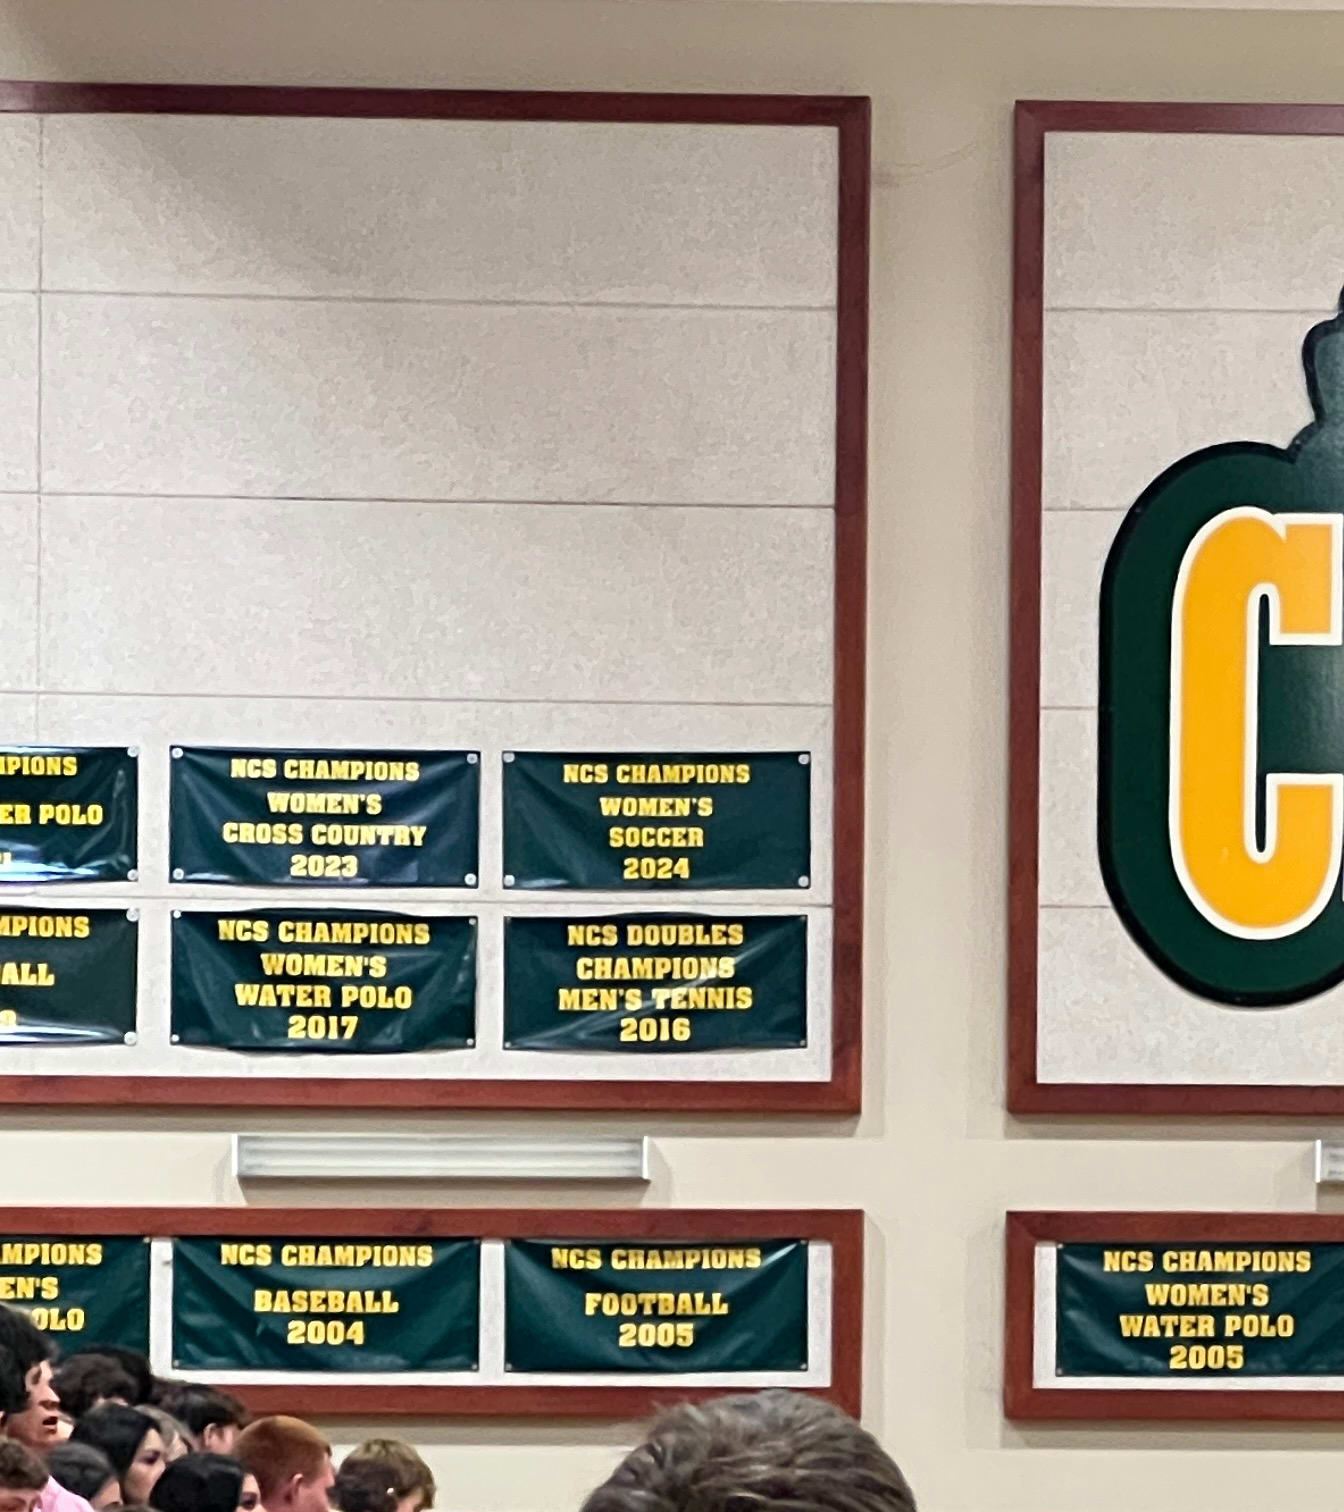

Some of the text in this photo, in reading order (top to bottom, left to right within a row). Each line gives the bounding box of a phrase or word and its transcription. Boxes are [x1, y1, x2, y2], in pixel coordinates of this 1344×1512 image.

[231, 758, 420, 780] NCS CHAMPIONS
[563, 763, 751, 784] NCS CHAMPIONS
[39, 803, 103, 825] POLO
[268, 792, 382, 814] WOMEN'S
[600, 796, 713, 817] WOMEN'S
[223, 822, 425, 845] CROSS COUNTRY
[609, 826, 704, 848] SOCCER
[290, 854, 359, 878] 2023
[623, 857, 690, 880] 2024
[218, 919, 431, 945] NCS CHAMPIONS
[567, 924, 744, 946] NCS DOUBLES
[260, 952, 387, 978] WOMEN'S
[576, 956, 735, 980] CHAMPIONS
[235, 983, 413, 1009] WATER POLO
[558, 986, 753, 1011] MEN'S TENNIS
[287, 1014, 359, 1039] 2017
[620, 1017, 691, 1042] 2016
[0, 1242, 103, 1265] MPIONS
[221, 1243, 434, 1267] NCS CHAMPIONS
[551, 1247, 762, 1270] NCS CHAMPIONS
[1103, 1250, 1312, 1273] NCS CHAMPIONS
[253, 1289, 400, 1314] BASEBALL
[585, 1292, 729, 1316] FOOTBALL
[1145, 1283, 1269, 1307] WOMEN'S
[29, 1307, 85, 1331] OLO
[1119, 1314, 1294, 1338] WATER POLO
[287, 1320, 365, 1346] 2004
[618, 1322, 694, 1347] 2005
[1169, 1344, 1244, 1370] 2005
